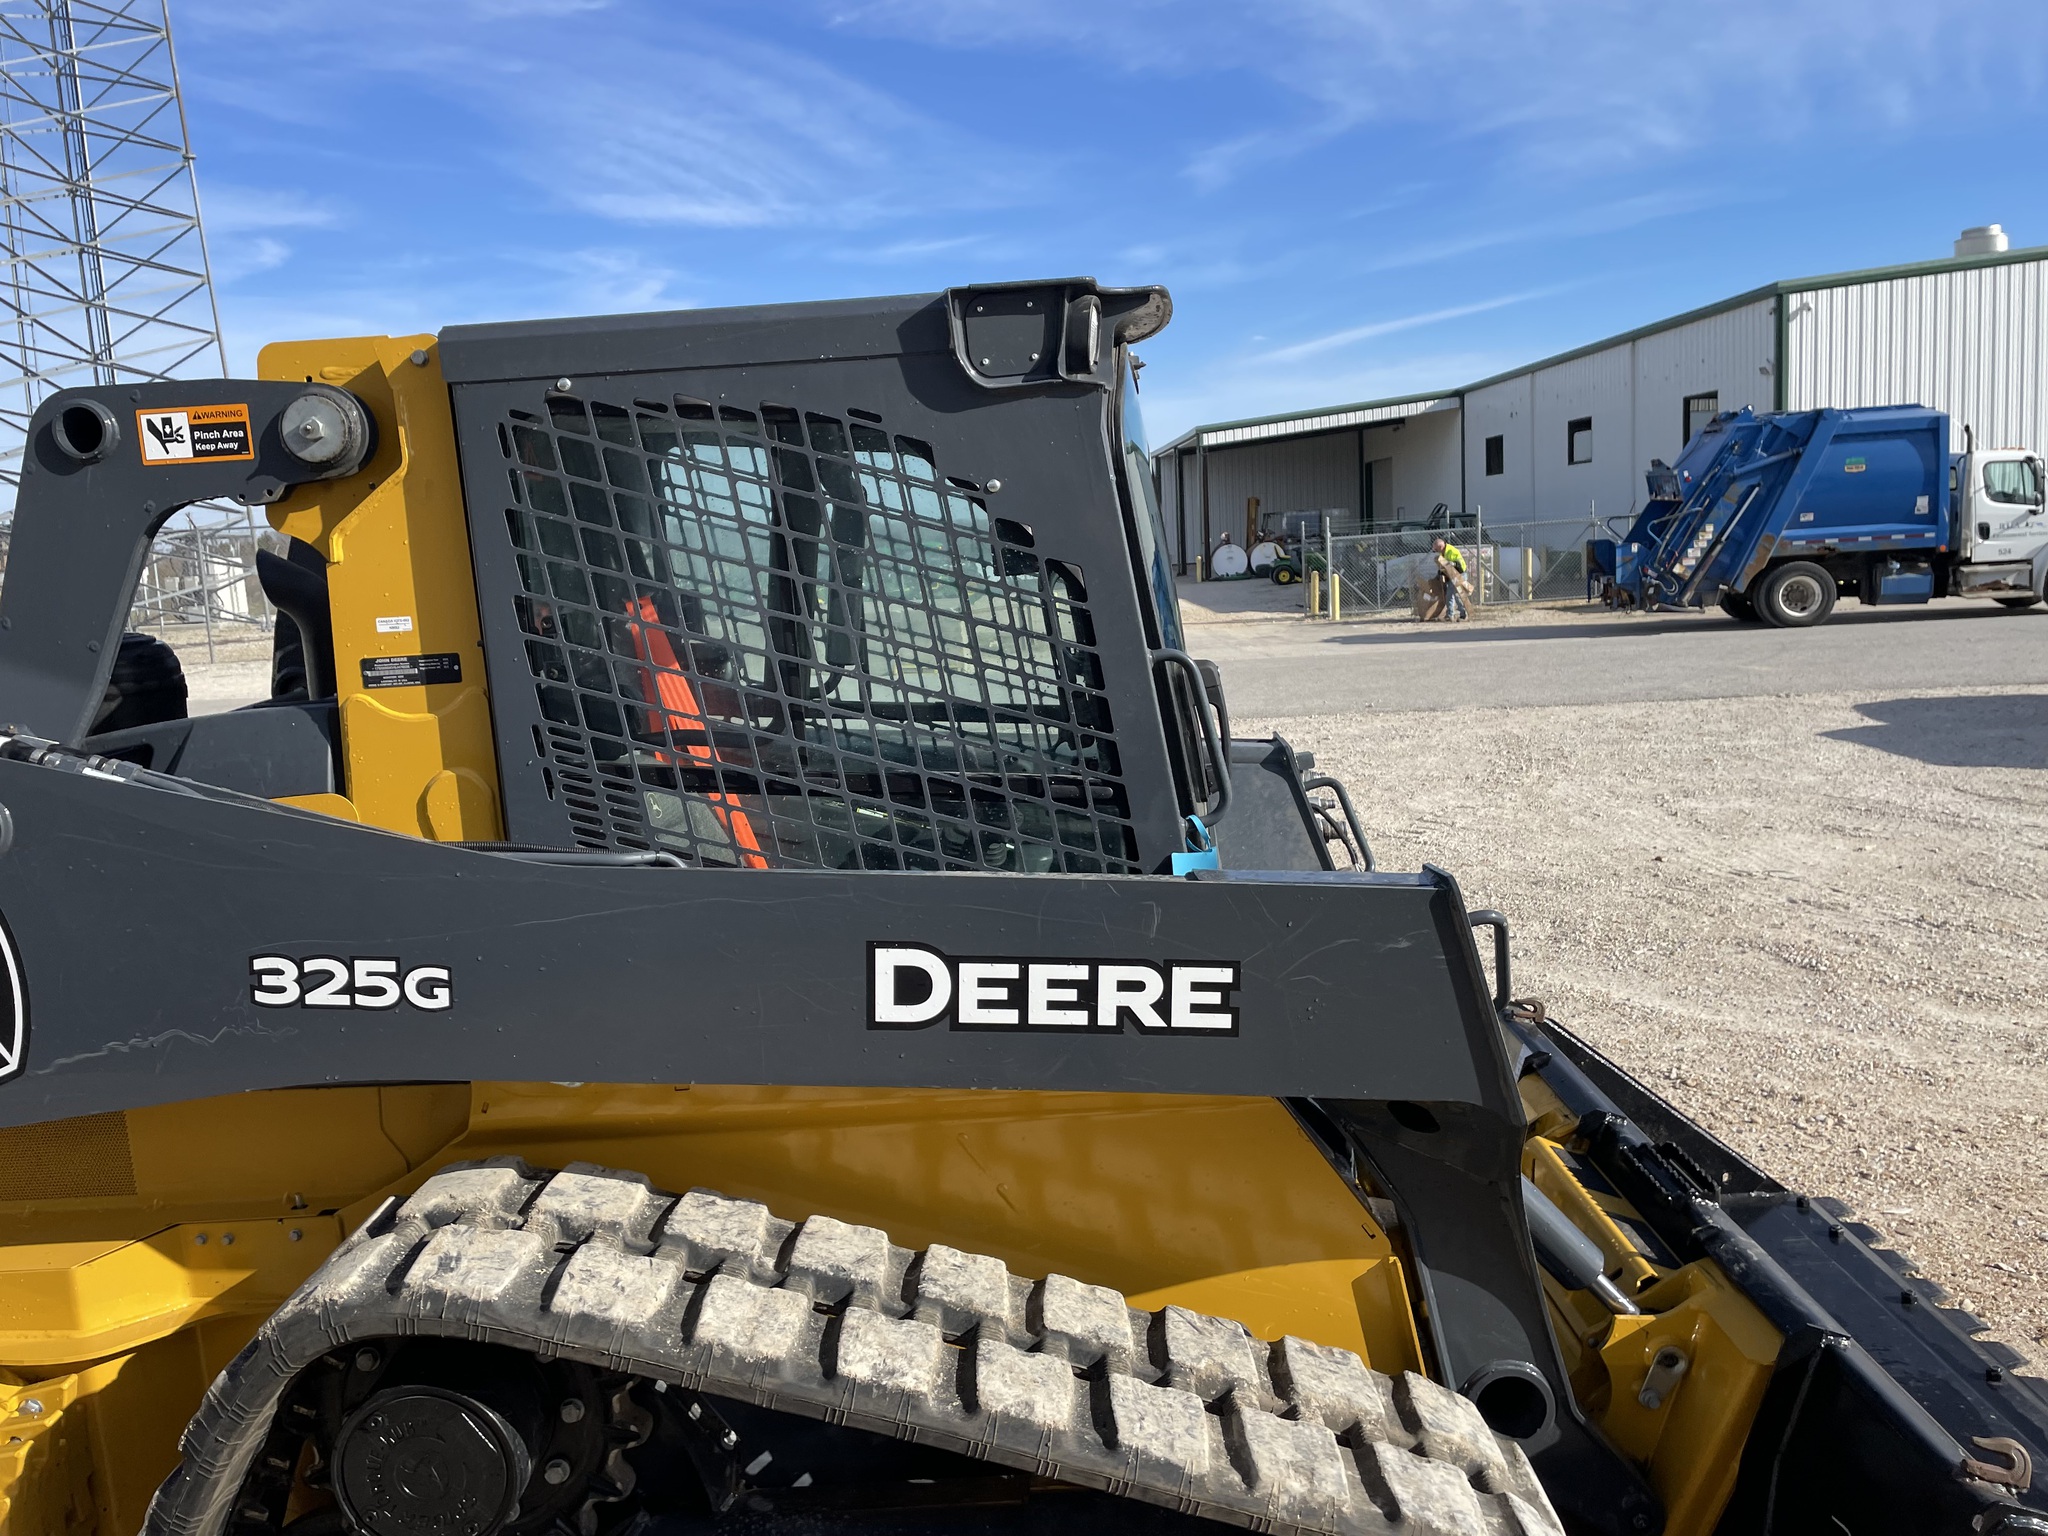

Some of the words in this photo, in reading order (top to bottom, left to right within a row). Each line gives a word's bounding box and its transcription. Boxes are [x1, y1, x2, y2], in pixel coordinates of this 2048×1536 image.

[201, 410, 243, 419] WARNING
[194, 430, 220, 440] Pinch
[222, 429, 244, 438] Area
[195, 442, 216, 451] Keep
[217, 441, 239, 450] Away
[251, 955, 451, 1010] 325G
[873, 946, 1235, 1030] DEERE
